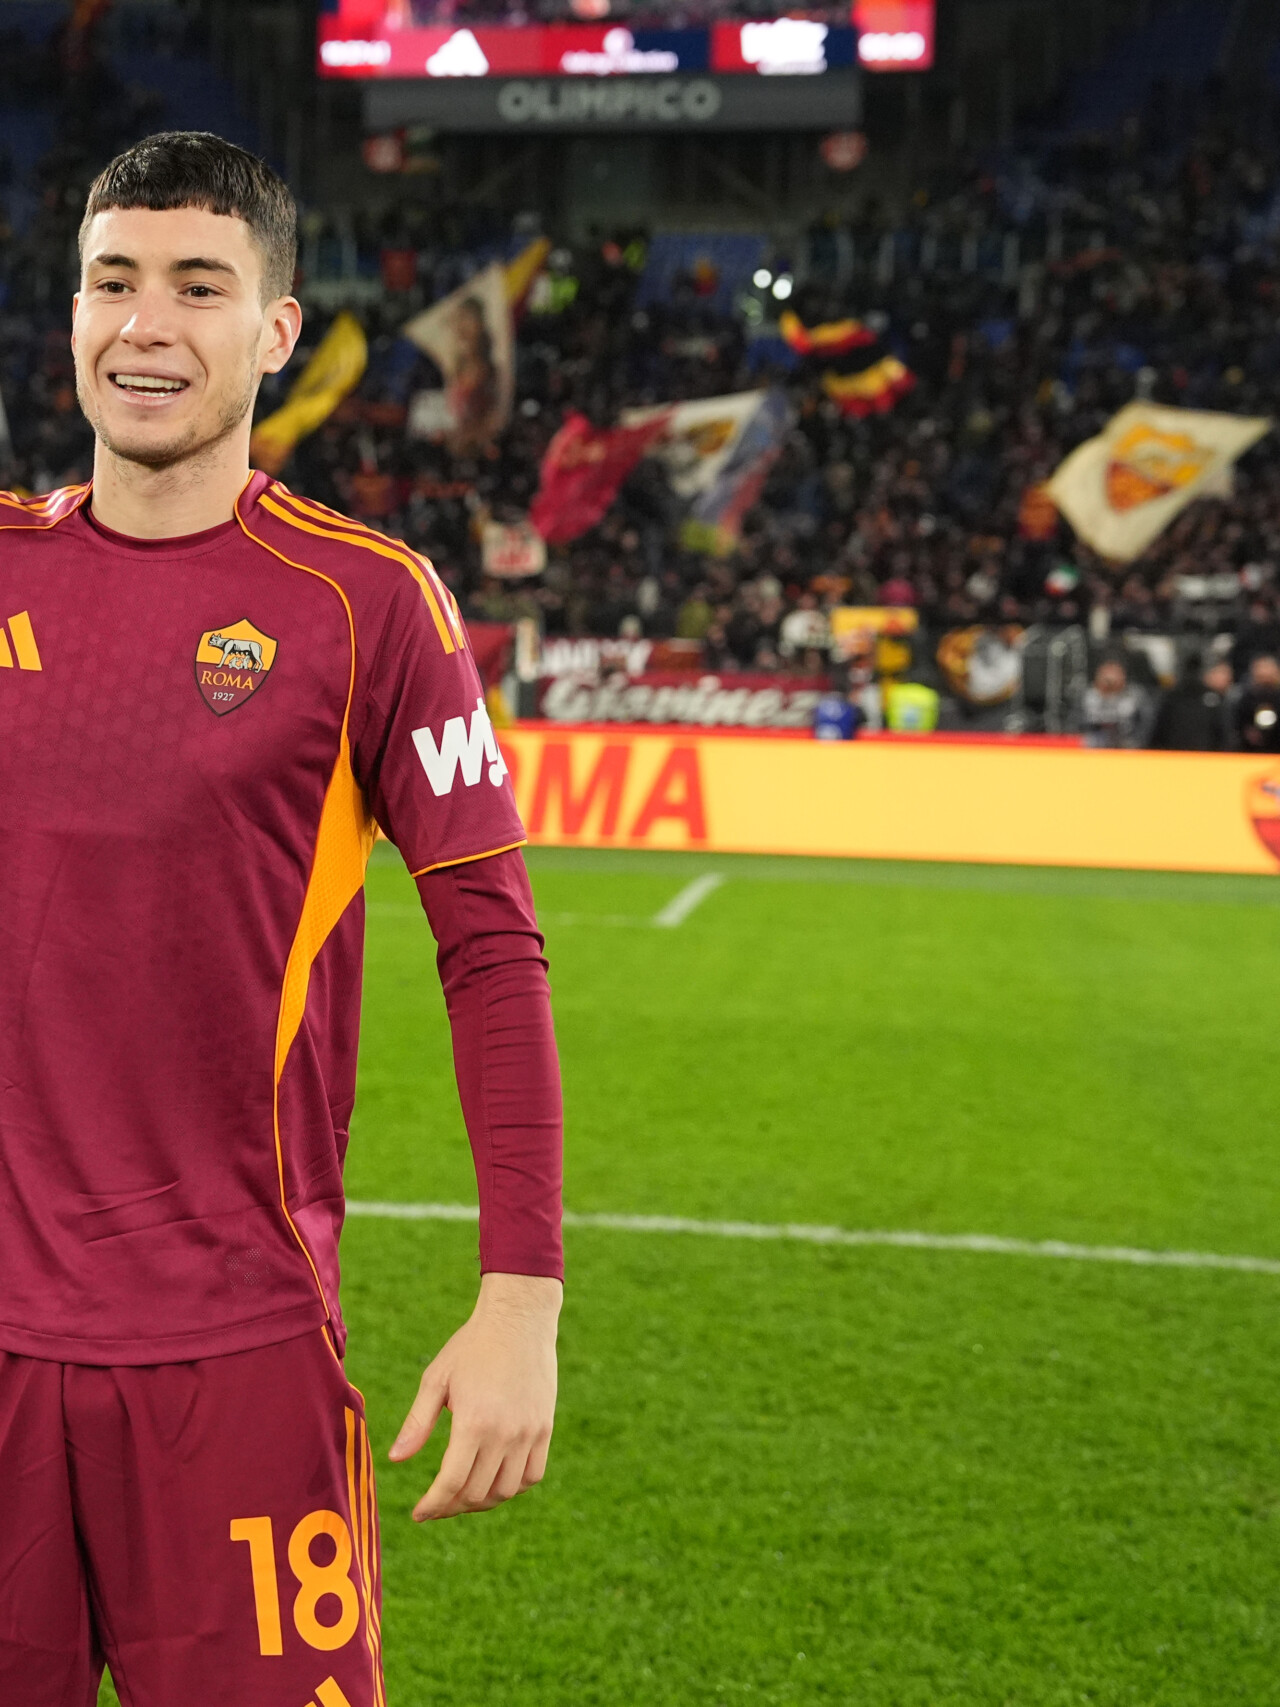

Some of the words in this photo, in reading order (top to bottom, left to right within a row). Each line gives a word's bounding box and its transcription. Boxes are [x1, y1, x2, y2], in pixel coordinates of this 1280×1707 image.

[499, 80, 719, 122] OLIMPICO
[200, 670, 255, 691] ROMA
[212, 691, 235, 702] 1927
[230, 1509, 360, 1656] 18
